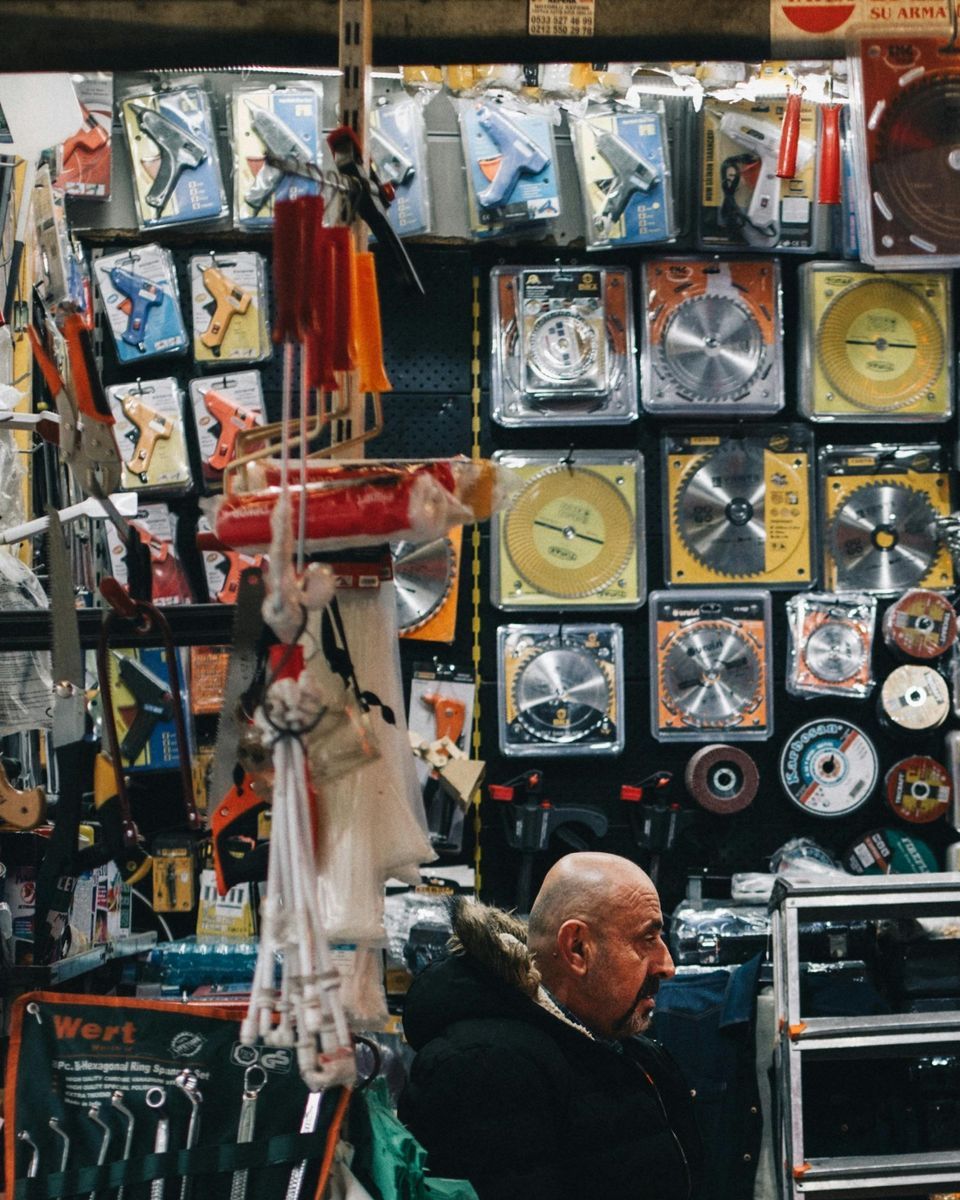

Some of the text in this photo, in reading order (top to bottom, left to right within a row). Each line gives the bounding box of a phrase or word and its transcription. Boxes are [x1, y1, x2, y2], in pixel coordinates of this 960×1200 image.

[870, 5, 893, 19] SU
[786, 723, 841, 785] Karbosan
[53, 1015, 136, 1045] Wert
[130, 1061, 151, 1074] Ring
